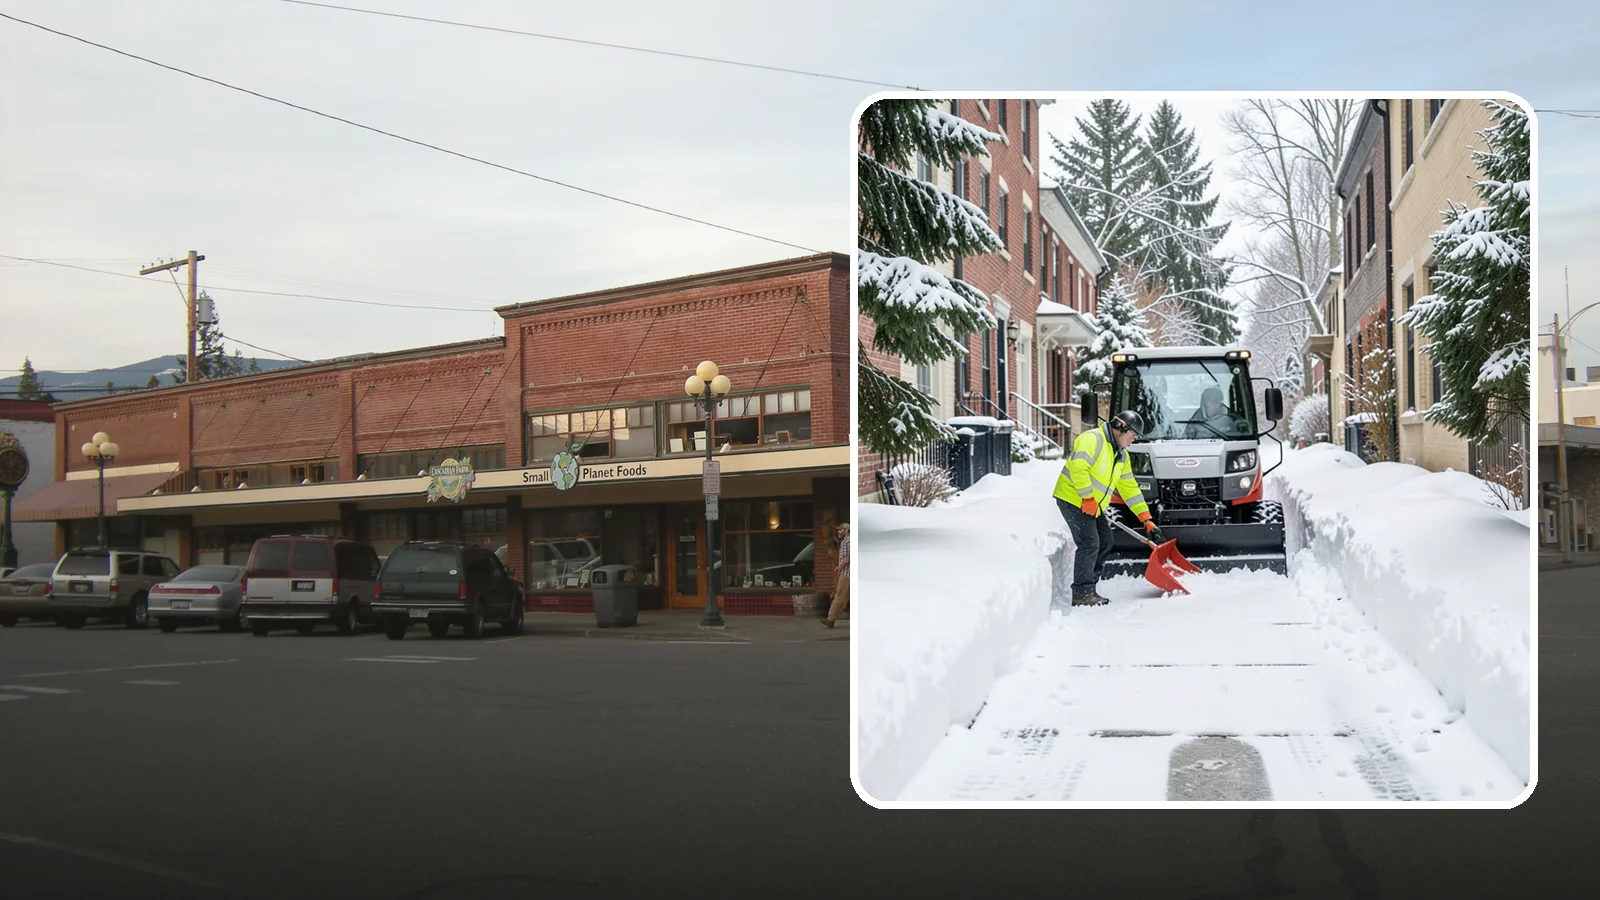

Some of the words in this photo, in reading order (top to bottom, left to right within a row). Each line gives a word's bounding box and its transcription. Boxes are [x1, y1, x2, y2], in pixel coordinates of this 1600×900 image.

[523, 471, 549, 483] Small
[583, 467, 614, 479] Planet
[617, 464, 647, 477] Foods
